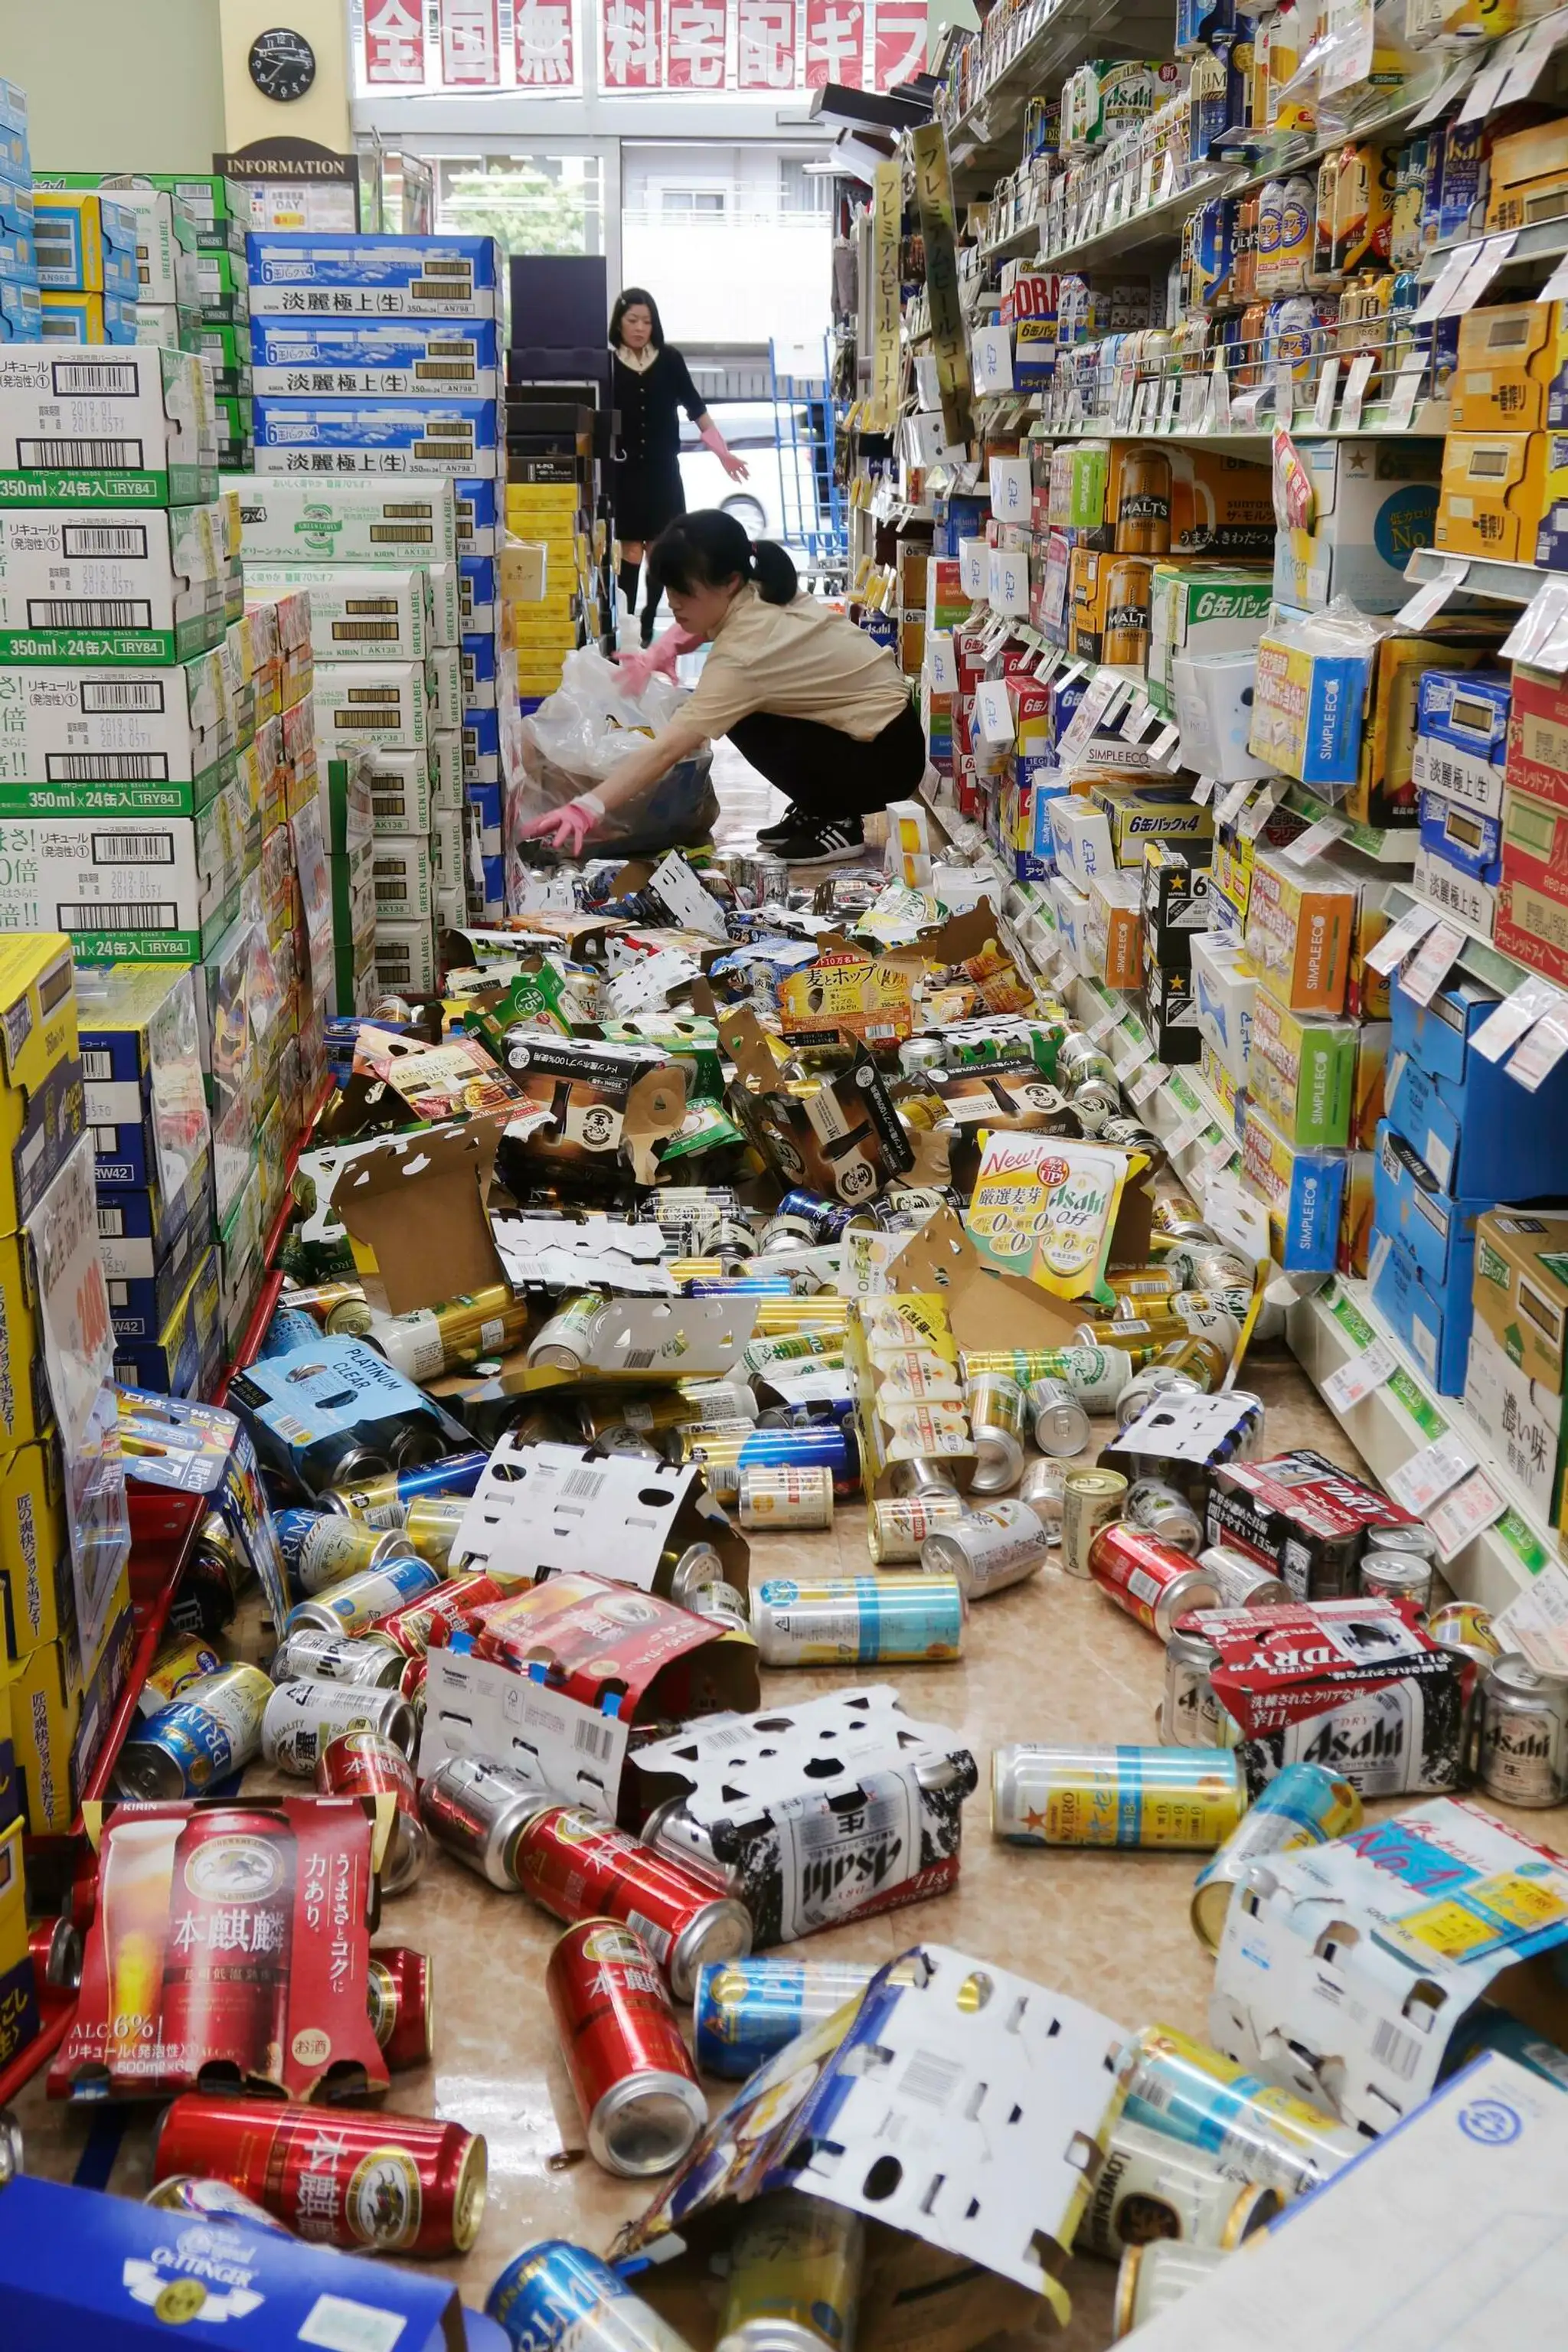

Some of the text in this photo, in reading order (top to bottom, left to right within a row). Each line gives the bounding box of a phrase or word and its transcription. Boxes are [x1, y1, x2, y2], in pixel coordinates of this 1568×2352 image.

[227, 159, 345, 175] INFORMATION
[276, 201, 300, 211] DAY
[283, 292, 404, 312] 淡麗極上(生)
[286, 373, 408, 394] 淡麗極上(生)
[286, 452, 407, 472] 淡麗極上(生)
[113, 482, 150, 495] 1RY84
[444, 495, 452, 524] LABEL
[1120, 501, 1168, 517] MALT'S
[9, 524, 58, 535] リキュール
[1181, 531, 1275, 546] うまみ、きわだつ。
[413, 589, 421, 655] GREEN LABEL
[120, 642, 158, 654] 1RY84
[28, 680, 77, 691] リキュール
[1320, 714, 1337, 760] SIMPLE
[1089, 749, 1123, 762] SIMPLE
[137, 794, 175, 805] 1RY84
[419, 766, 427, 830] GREEN LABEL
[40, 833, 89, 844] リキュール
[420, 882, 428, 913] GREEN
[148, 942, 184, 954] 1RY84
[805, 964, 878, 988] 麦とホップ
[1307, 946, 1323, 990] SIMPLE
[1310, 1082, 1327, 1125] SIMPLE
[982, 1146, 1044, 1177] New!
[979, 1187, 1042, 1206] 厳選麦芽
[1048, 1184, 1107, 1216] Asahi
[1056, 1211, 1093, 1226] Off
[1299, 1209, 1315, 1250] SIMPLE
[332, 1362, 373, 1390] CLEAR
[344, 1348, 403, 1392] PLATINUM
[1304, 1717, 1404, 1763] Asahi
[1485, 1723, 1551, 1759] Asahi
[122, 1802, 157, 1811] KIRIN
[172, 1910, 285, 1954] 本麒麟
[329, 1853, 353, 1994] うまさとコクに
[295, 2040, 328, 2056] お酒
